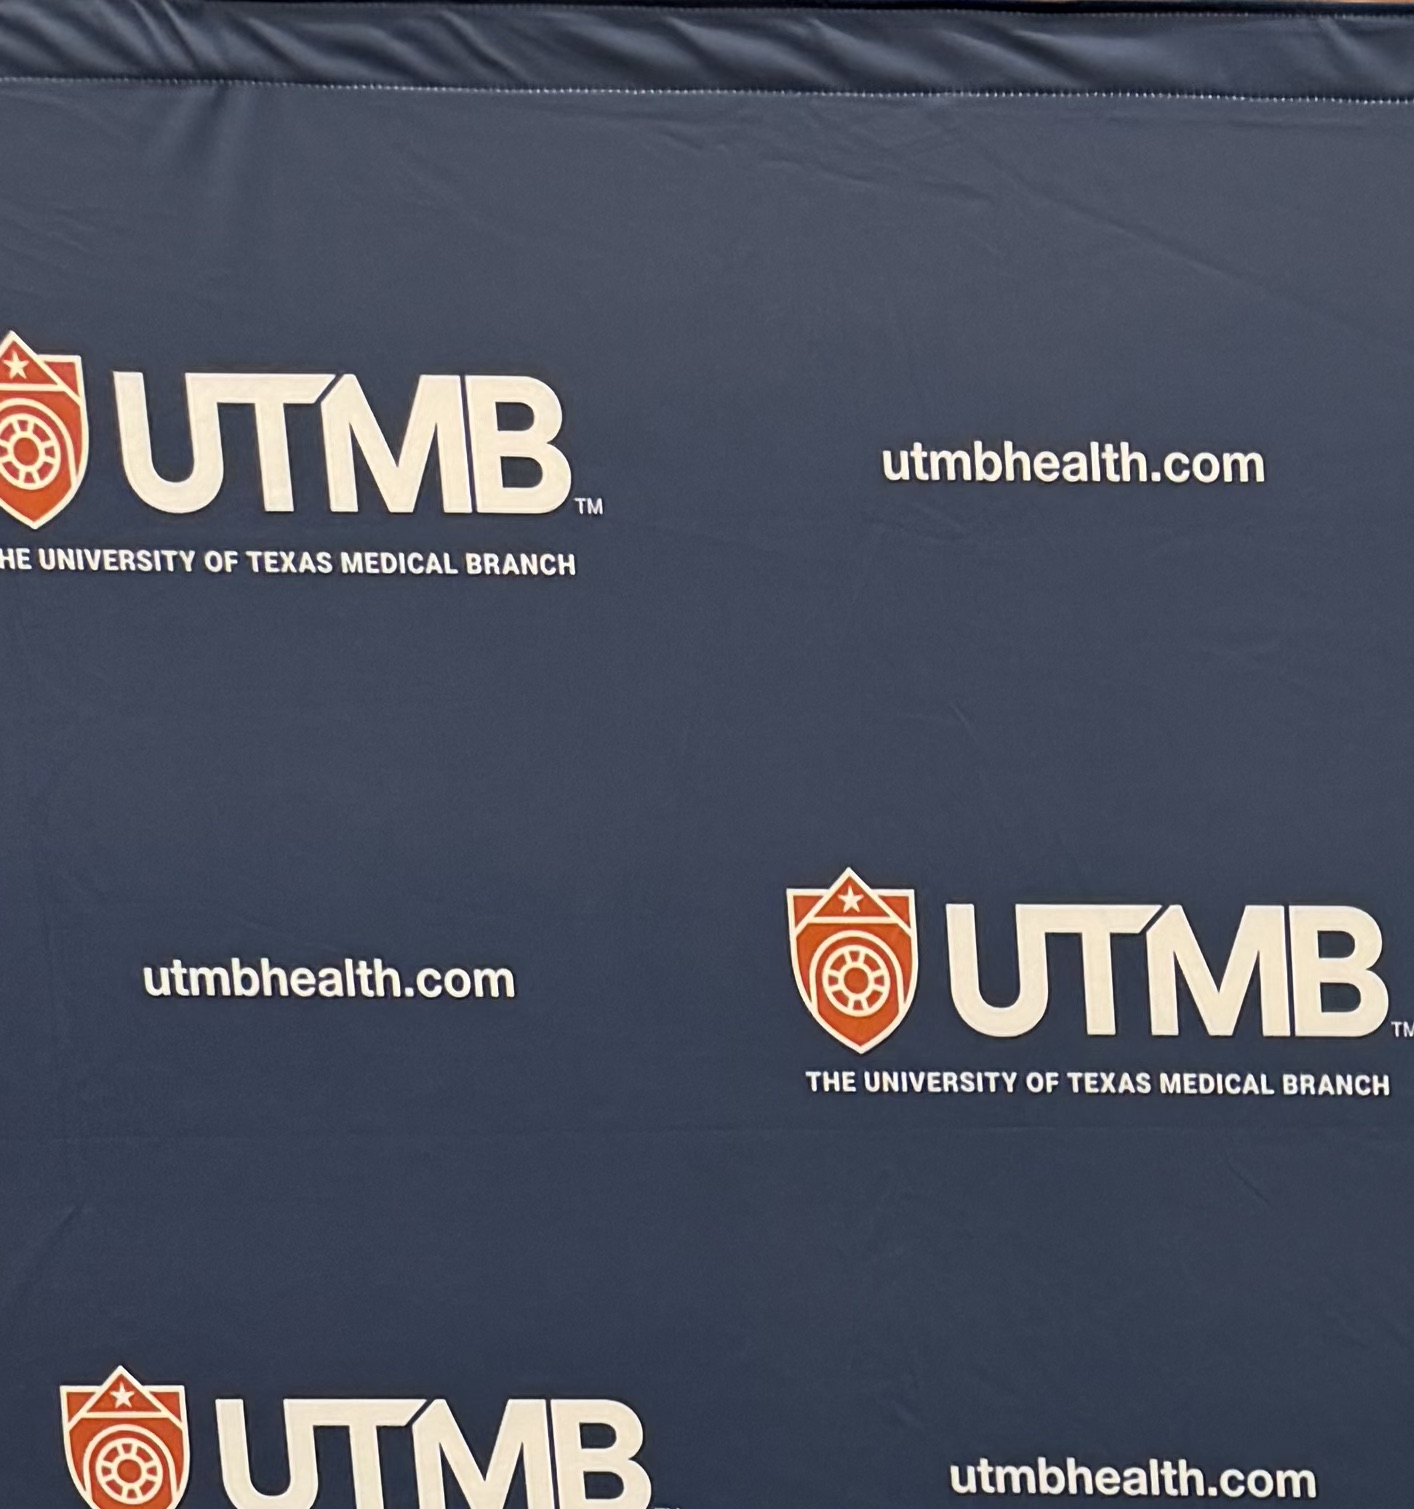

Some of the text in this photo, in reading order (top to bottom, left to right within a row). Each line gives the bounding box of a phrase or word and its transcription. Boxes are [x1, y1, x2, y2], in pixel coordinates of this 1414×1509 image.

[113, 371, 571, 513] UTMB
[882, 439, 1265, 484] utmbhealth.com
[142, 957, 515, 998] utmbhealth.com
[946, 904, 1388, 1037] UTMB
[804, 1070, 1390, 1096] THE UNIVERSITY OF TEXAS MEDICAL BRANCH
[950, 1456, 1317, 1499] utmbhealth.com
